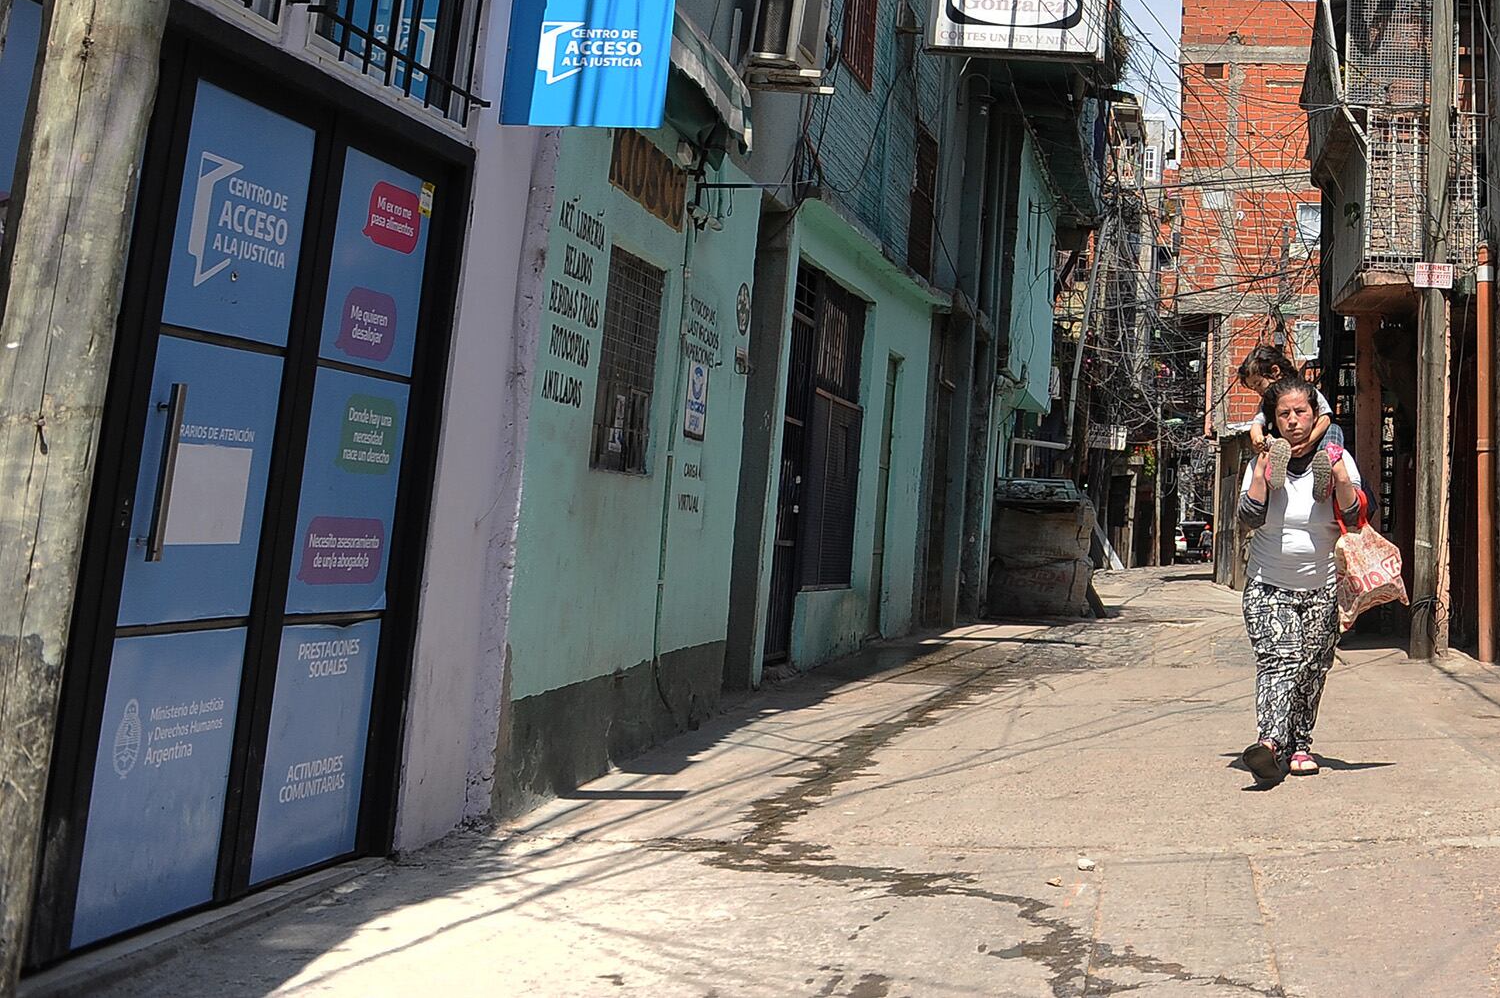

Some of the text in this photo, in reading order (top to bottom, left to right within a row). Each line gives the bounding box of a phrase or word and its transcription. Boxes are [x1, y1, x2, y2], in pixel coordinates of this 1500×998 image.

[571, 29, 638, 39] CENTRO DE
[940, 31, 986, 42] CORTES
[989, 32, 1033, 43] UNISEX
[565, 40, 642, 56] ACCESO
[561, 57, 642, 68] A LA JUSTICIA
[229, 177, 289, 212] CENTRO DE
[218, 200, 288, 246] ACCESO
[371, 213, 415, 238] pasa alimentos
[213, 233, 286, 270] A LA JUSTICIA
[563, 243, 594, 286] HELADOS
[1416, 264, 1451, 272] INTERNET
[548, 279, 580, 320] BEBIDAS
[351, 305, 388, 328] Me quieren
[351, 323, 384, 346] desalojar
[349, 407, 392, 429] Donde hay una
[179, 424, 256, 443] RARIOS DE ATENCIÓN
[353, 430, 384, 446] necesidad
[343, 448, 358, 462] nace
[367, 447, 390, 464] derecho
[677, 493, 699, 513] VIRTUAL
[309, 533, 380, 549] Necesito asesoramiento
[313, 552, 322, 568] de
[298, 638, 360, 661] PRESTACIONES
[308, 658, 348, 679] SOCIALES
[150, 698, 224, 722] Ministerio de Justicia
[147, 718, 223, 746] y Derechos Humanos
[144, 741, 193, 768] Argentina
[286, 754, 344, 783] ACTIVIDADES
[279, 772, 345, 804] COMUNITARIAS
